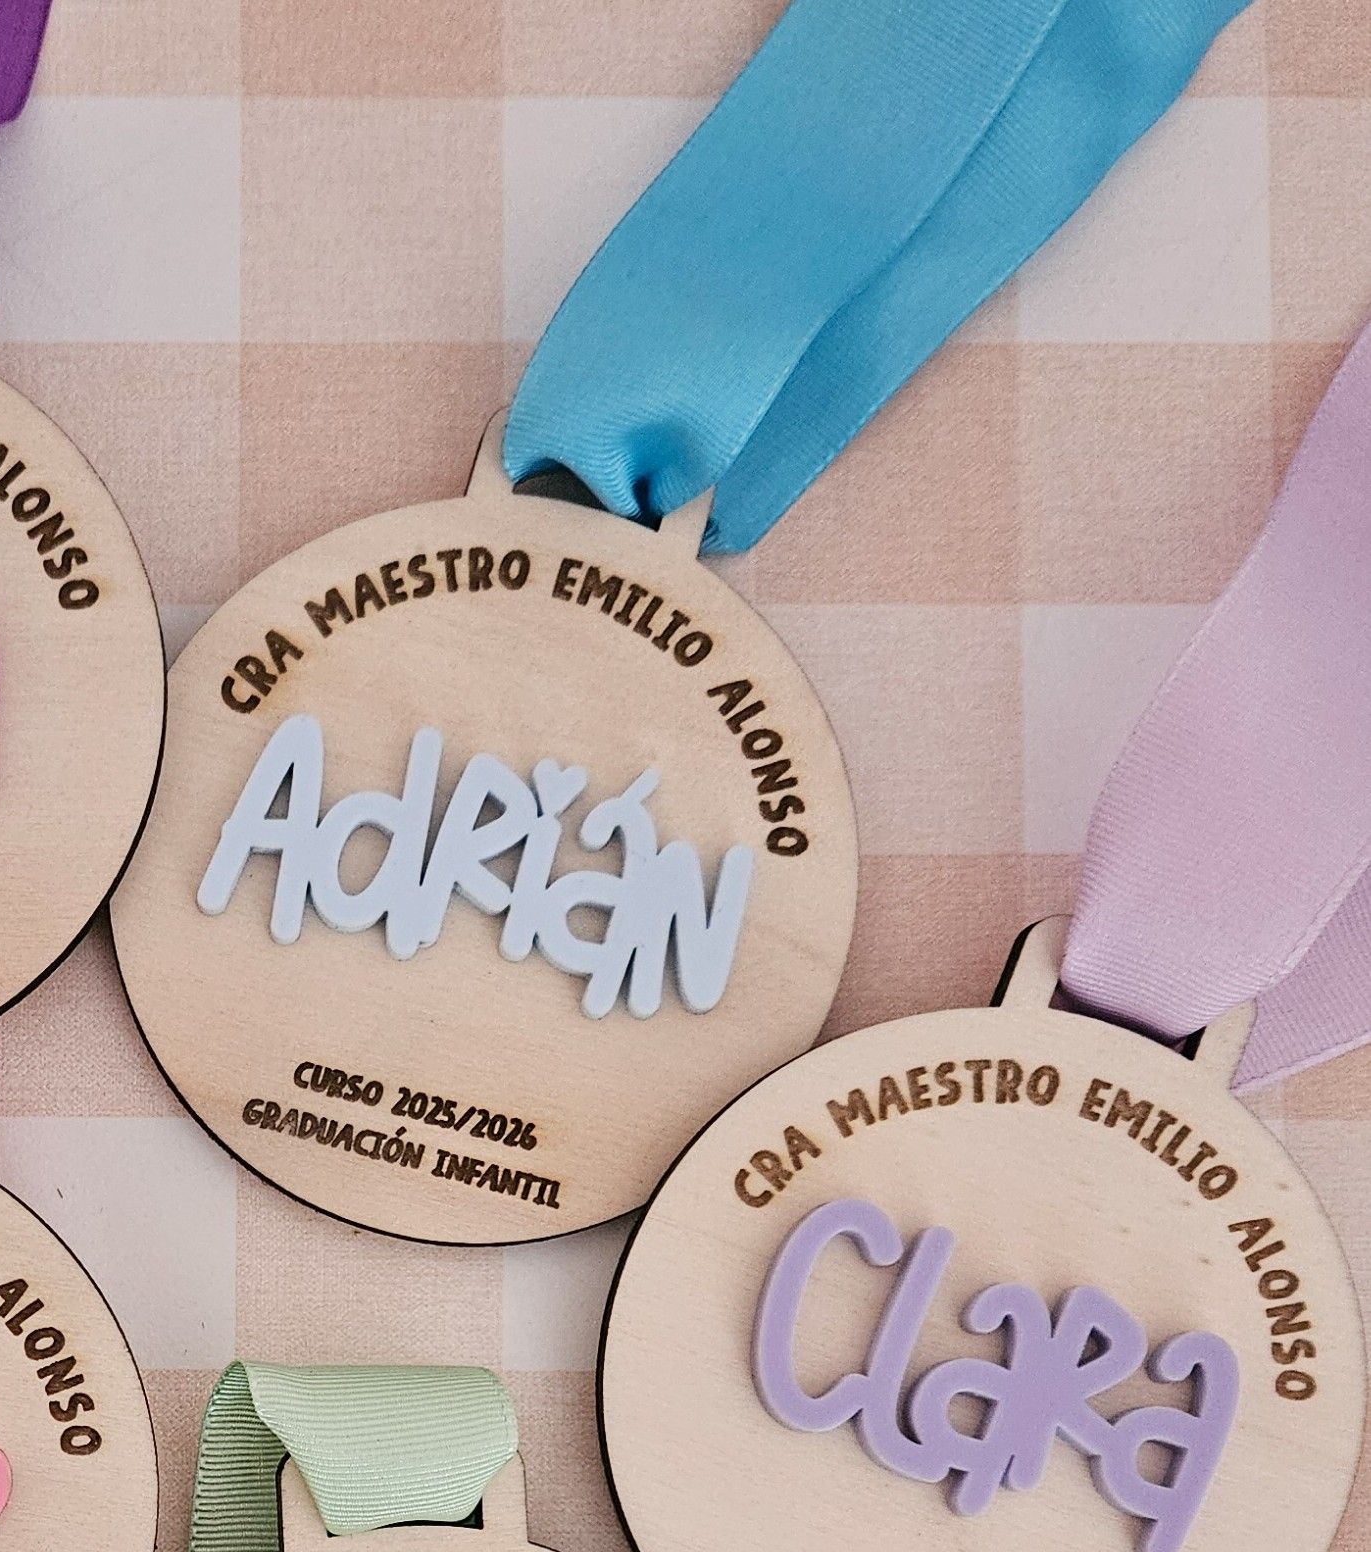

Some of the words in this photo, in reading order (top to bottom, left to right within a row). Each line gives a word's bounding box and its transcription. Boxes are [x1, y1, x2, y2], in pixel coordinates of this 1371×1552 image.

[221, 630, 304, 714] CRA
[304, 547, 531, 638] MAESTRO
[552, 558, 713, 667] EMILIO
[707, 679, 809, 857] ALONSO
[242, 1098, 425, 1169] GRADUACIÓN
[431, 1149, 560, 1209] INFANTIL
[294, 1061, 384, 1106] CURSO
[391, 1086, 537, 1151] 2025/2026
[735, 1126, 821, 1208] CRA
[826, 1059, 1060, 1137] MAESTRO
[1079, 1078, 1238, 1200] EMILIO
[1228, 1218, 1316, 1400] ALONSO
